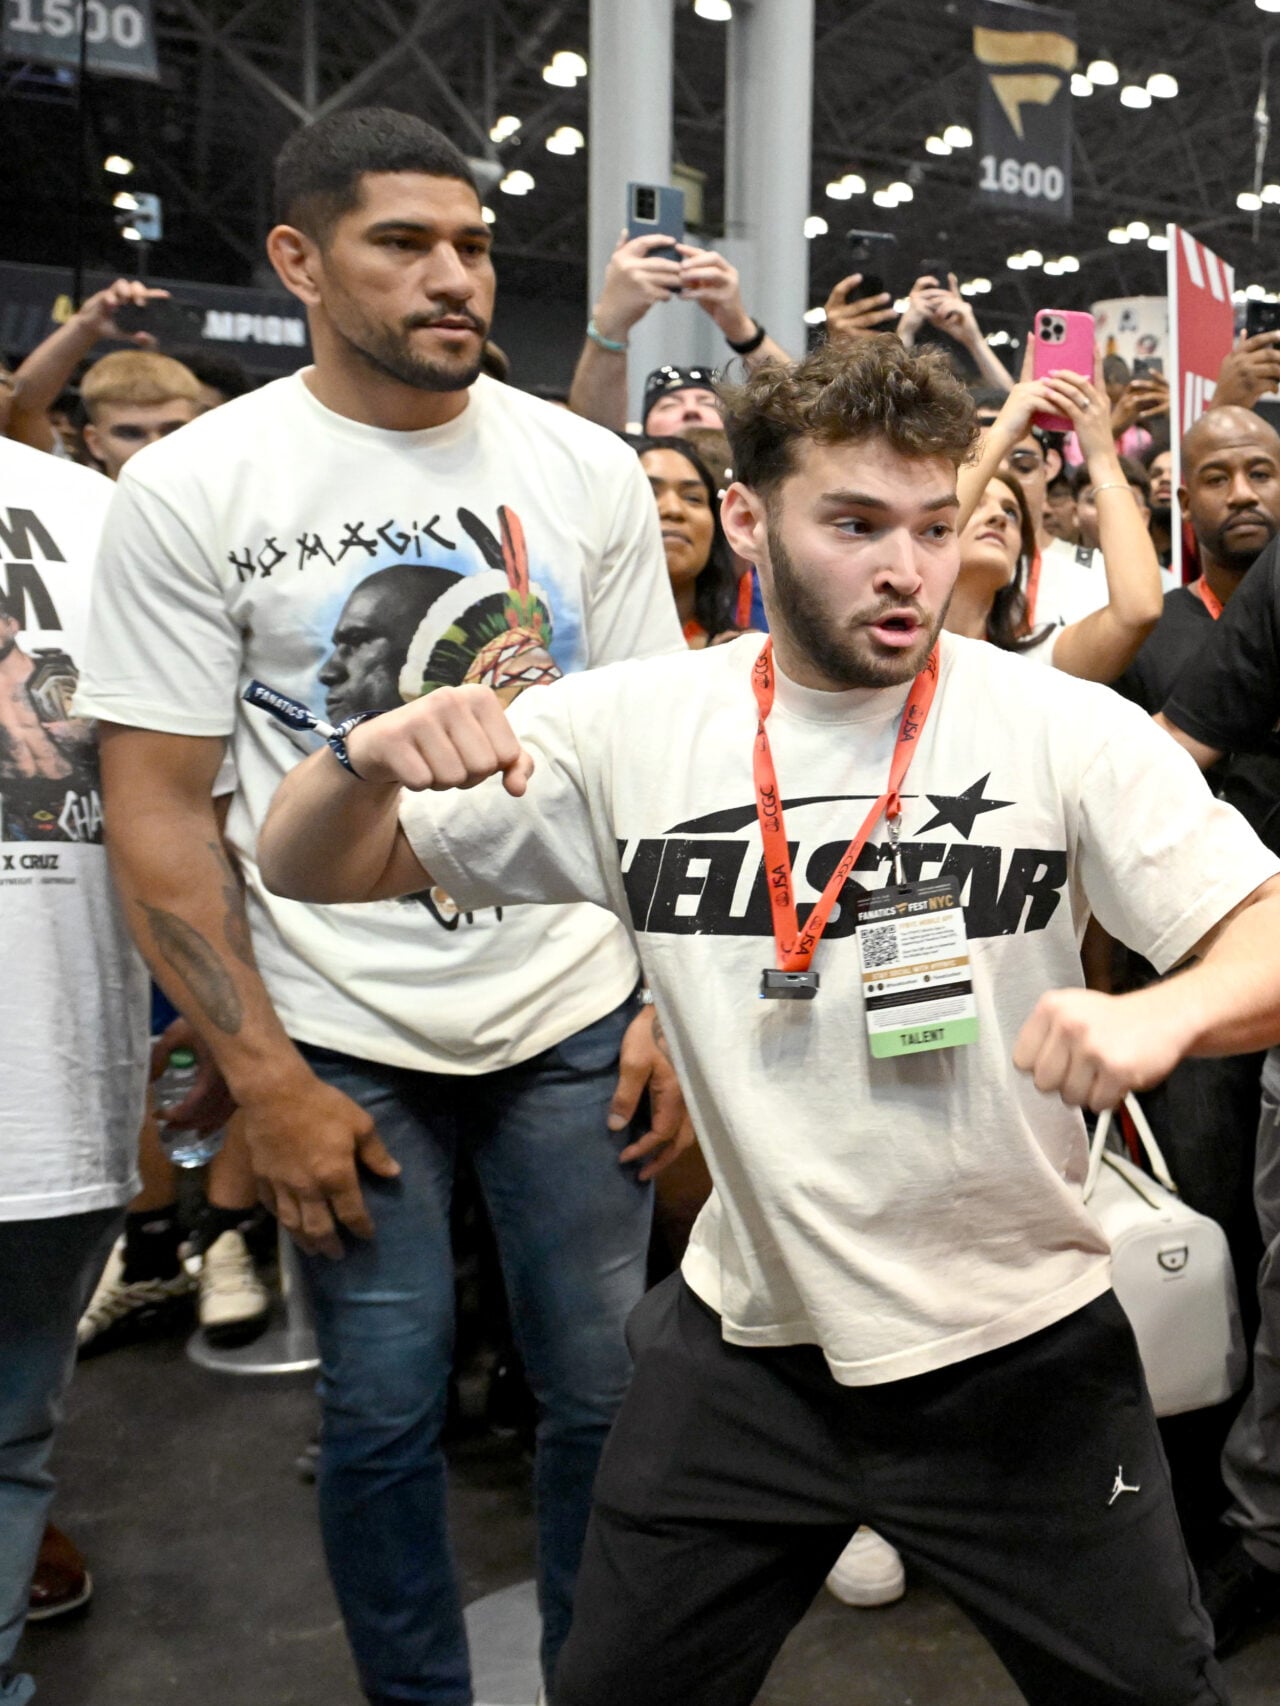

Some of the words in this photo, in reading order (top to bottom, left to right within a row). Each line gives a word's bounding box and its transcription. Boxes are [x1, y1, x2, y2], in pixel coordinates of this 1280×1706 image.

[9, 0, 146, 49] 1500
[979, 154, 1065, 202] 1600
[203, 309, 306, 347] MPION
[254, 686, 306, 720] FANATICS
[900, 719, 919, 743] JSA
[760, 784, 779, 817] CGC
[2, 855, 15, 870] X
[19, 854, 60, 870] CRUZ
[771, 863, 790, 893] JSA
[858, 906, 897, 921] FANATICS
[908, 900, 929, 913] FEST
[929, 894, 954, 911] NYC
[796, 930, 816, 956] JSA
[900, 1027, 945, 1047] TALENT
